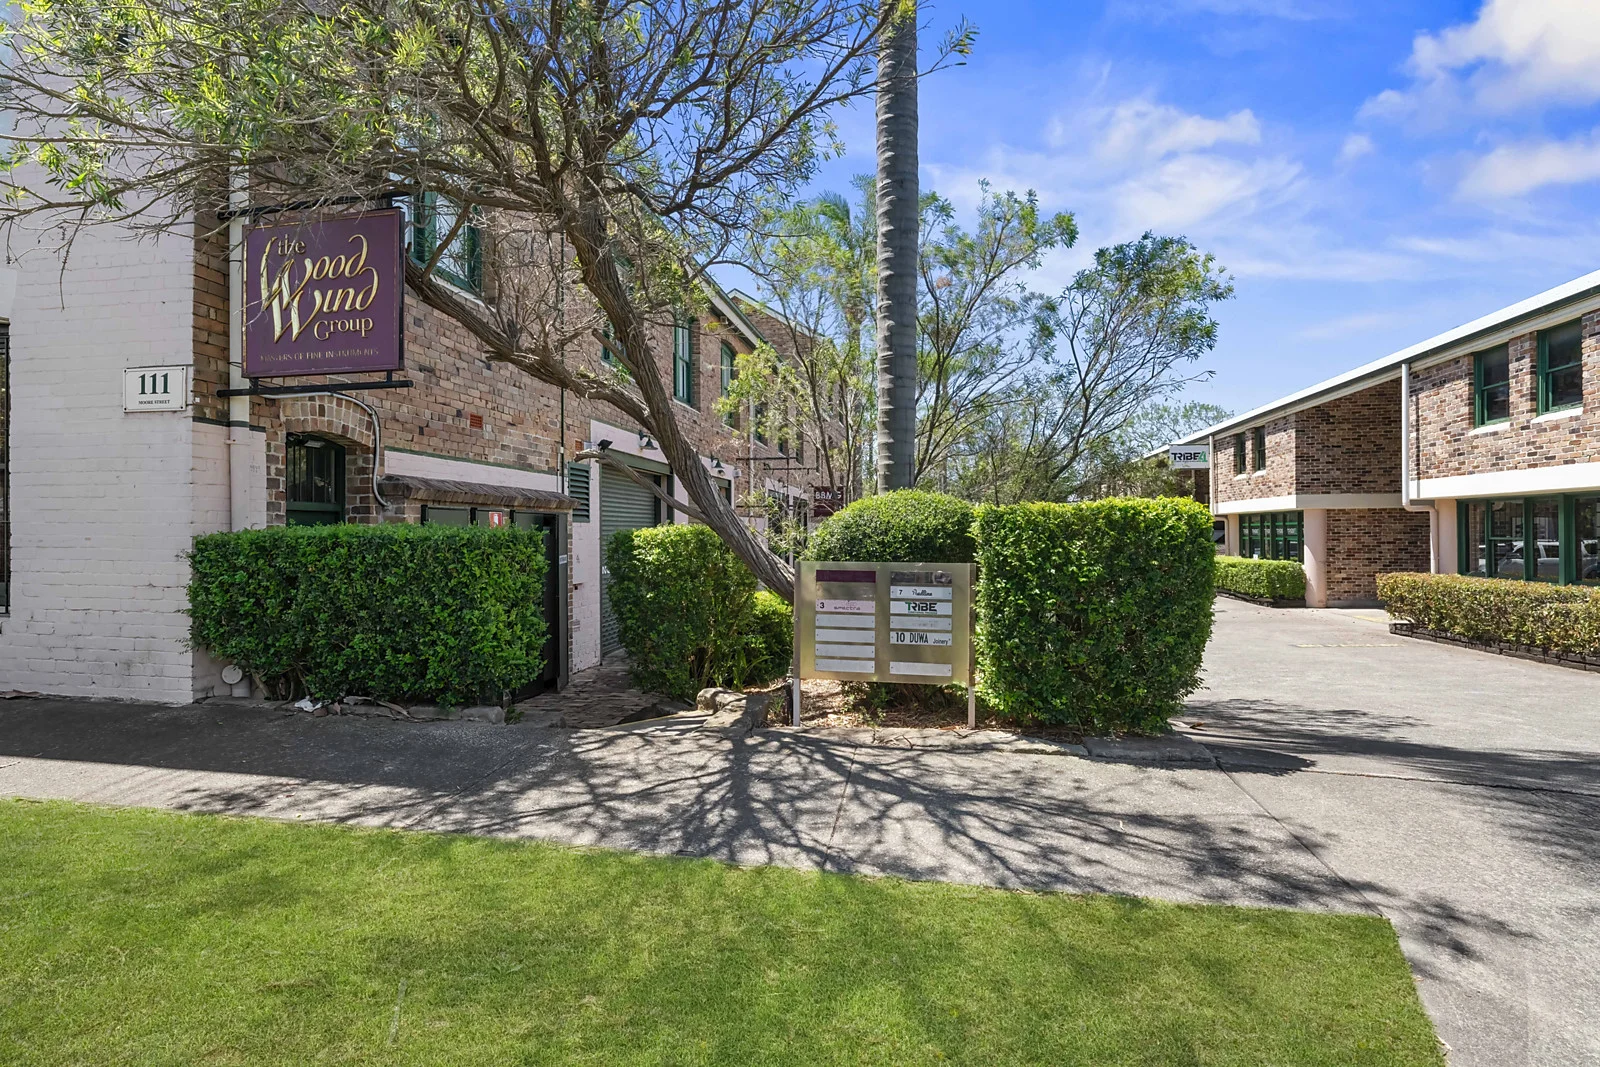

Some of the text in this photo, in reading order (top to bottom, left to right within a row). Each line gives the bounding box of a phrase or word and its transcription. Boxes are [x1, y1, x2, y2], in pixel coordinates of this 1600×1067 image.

[278, 233, 306, 256] the
[260, 233, 368, 312] Wood
[270, 266, 379, 344] Wind
[314, 317, 374, 341] Group
[294, 351, 303, 360] OF
[306, 350, 323, 360] FINE
[138, 372, 171, 395] 111
[819, 601, 825, 609] 3
[905, 602, 938, 612] TRIBE
[896, 632, 948, 646] 10 DUWA Joinery
